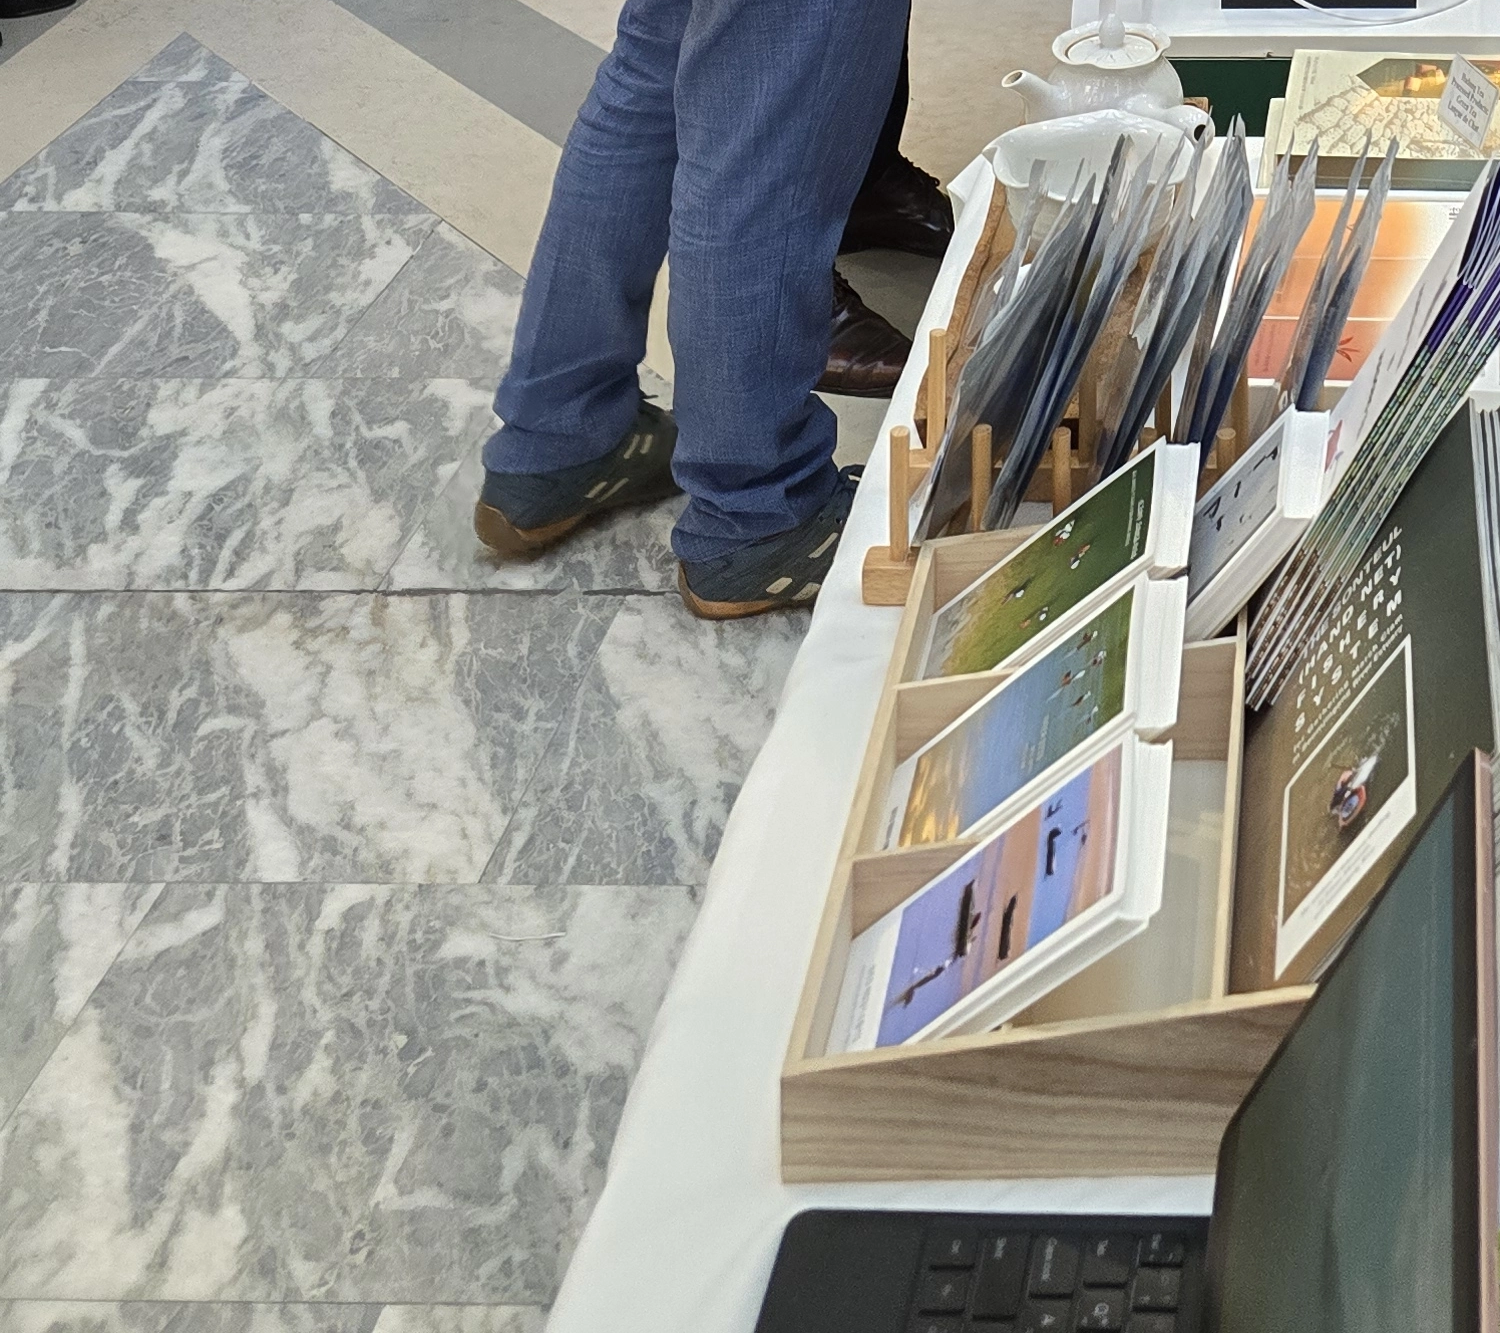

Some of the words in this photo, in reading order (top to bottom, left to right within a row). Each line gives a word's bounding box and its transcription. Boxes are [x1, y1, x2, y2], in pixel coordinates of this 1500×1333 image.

[1298, 605, 1354, 685] (HAND
[1360, 544, 1402, 602] NET)
[1332, 525, 1402, 619] SONTEUL
